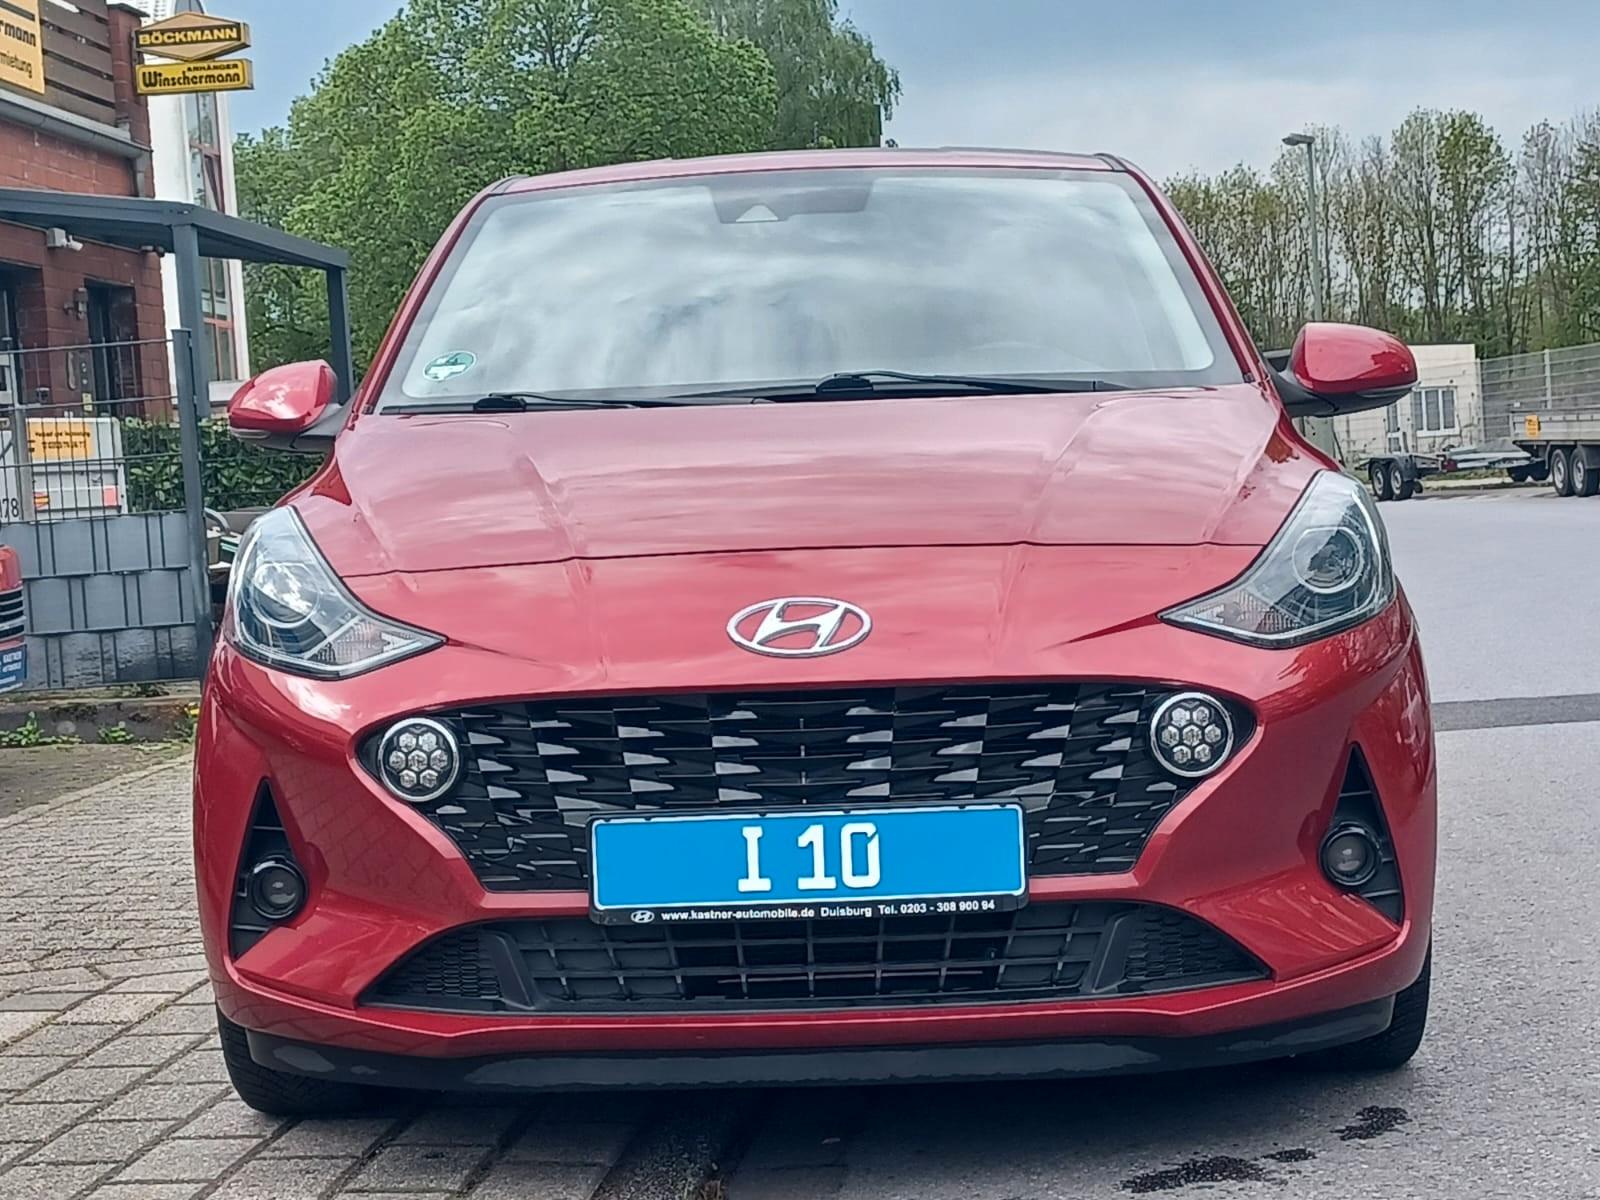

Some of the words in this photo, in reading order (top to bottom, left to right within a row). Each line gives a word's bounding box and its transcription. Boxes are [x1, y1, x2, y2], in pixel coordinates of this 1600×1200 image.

[139, 28, 238, 45] BÖCKMANN
[142, 69, 241, 88] Winschermann
[738, 824, 772, 892] I
[797, 822, 881, 889] 10
[660, 907, 815, 921] www.kastner-automobile.de
[820, 906, 873, 918] Duisburg
[877, 904, 898, 915] Tel.
[900, 902, 927, 914] 0203
[958, 901, 979, 911] 900
